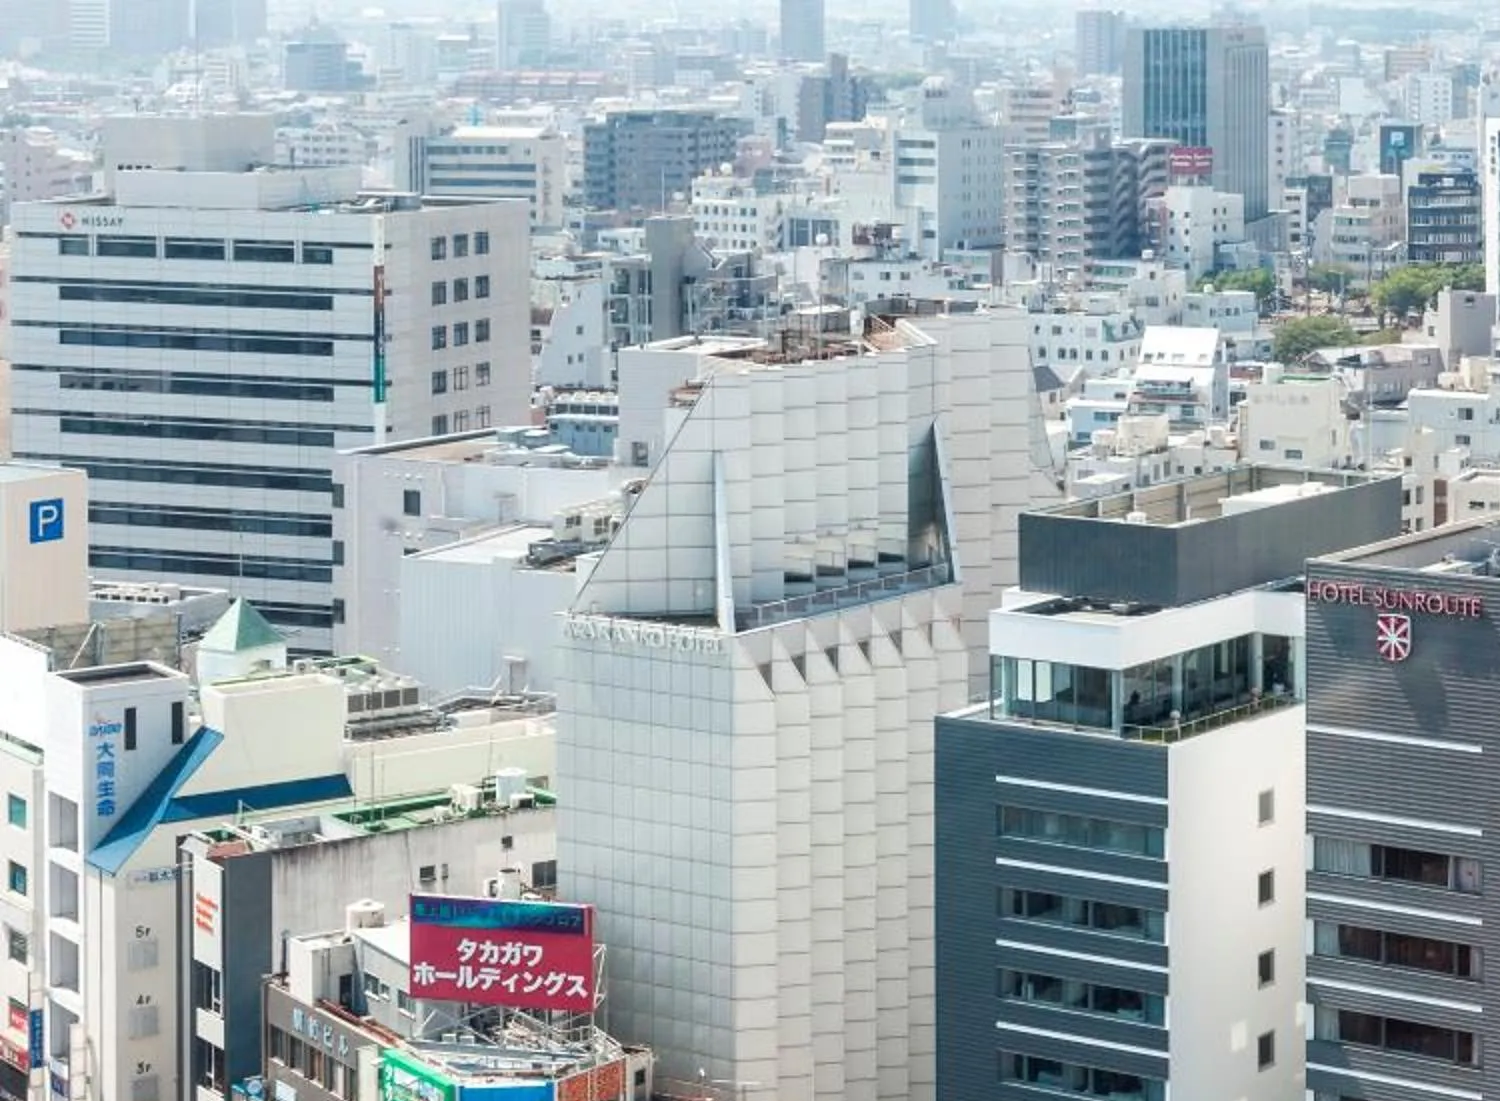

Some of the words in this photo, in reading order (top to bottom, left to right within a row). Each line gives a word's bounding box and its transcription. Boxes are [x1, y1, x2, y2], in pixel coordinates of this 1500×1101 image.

[38, 505, 58, 537] P
[1308, 580, 1372, 606] HOTEL
[1374, 588, 1480, 618] SUNROUTE
[95, 741, 116, 817] 大同生命
[457, 938, 543, 966] タカガワ
[413, 962, 588, 998] ホールディングス
